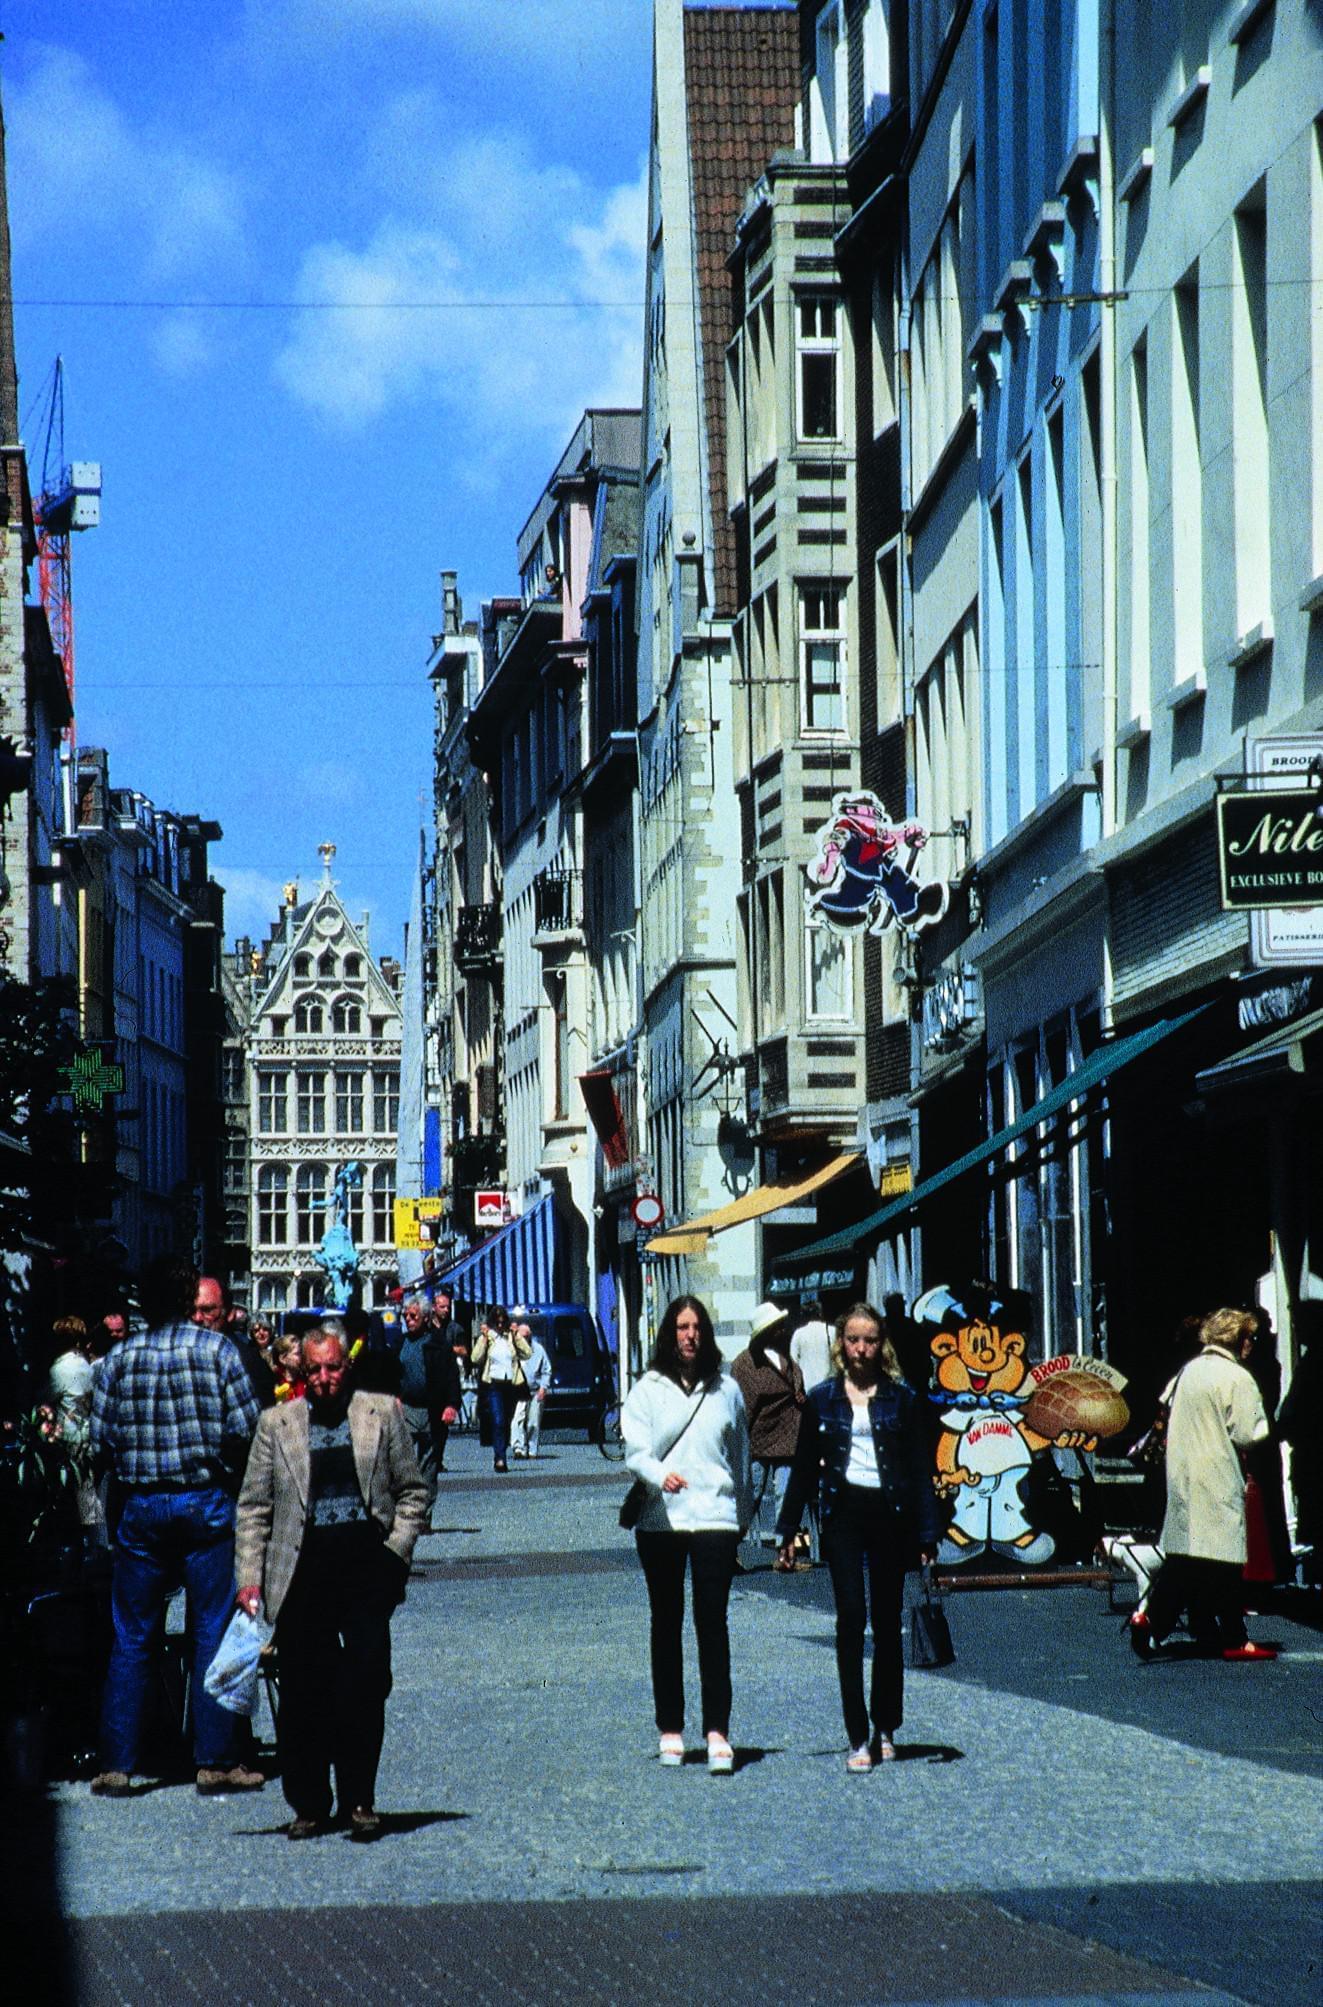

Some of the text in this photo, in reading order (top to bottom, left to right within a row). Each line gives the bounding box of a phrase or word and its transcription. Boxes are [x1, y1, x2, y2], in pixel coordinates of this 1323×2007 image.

[1230, 872, 1303, 888] EXCLUSIEVE
[1031, 1356, 1070, 1383] BROOD
[967, 1422, 1012, 1445] VAN DAMME
